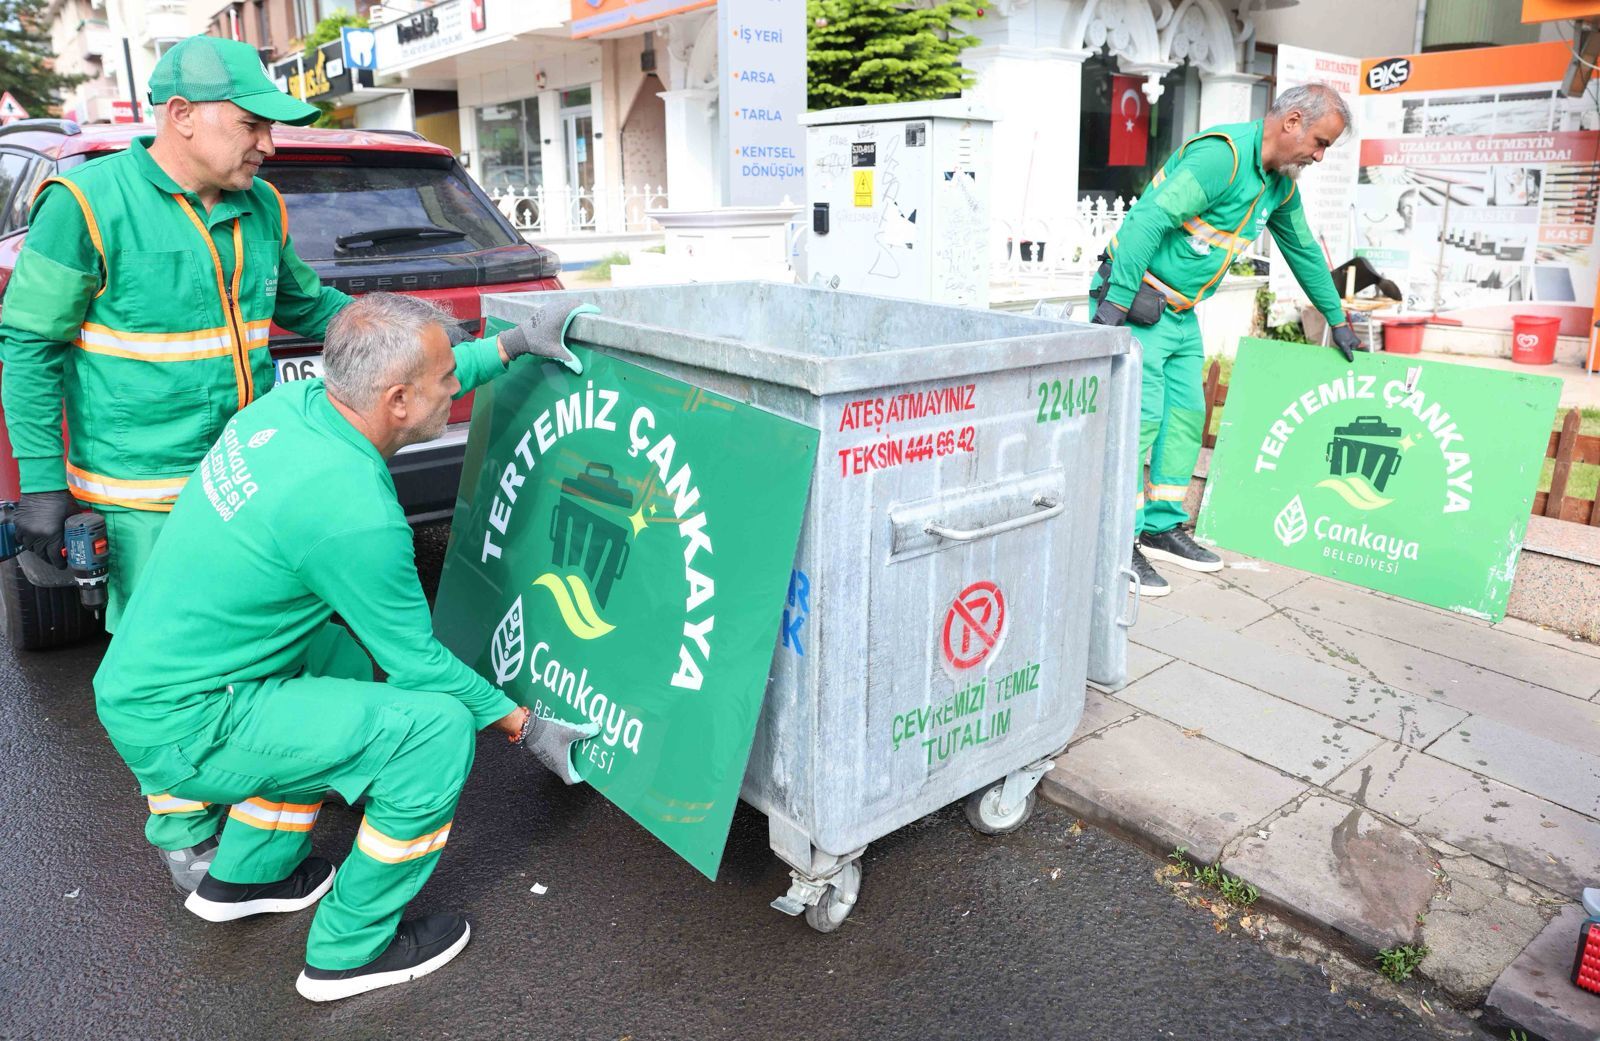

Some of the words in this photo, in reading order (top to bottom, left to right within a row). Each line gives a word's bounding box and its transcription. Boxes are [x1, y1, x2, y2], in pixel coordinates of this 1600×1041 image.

[740, 25, 752, 43] İŞ
[755, 29, 783, 43] YERİ
[740, 71, 775, 84] ARSA
[1370, 60, 1407, 88] BKS
[742, 109, 782, 121] TARLA
[742, 146, 795, 158] KENTSEL
[1399, 140, 1472, 153] UZAKLARA
[1476, 136, 1554, 150] GİTMEYİN
[1440, 151, 1498, 164] MATBAA
[1503, 149, 1572, 162] BURADA!
[742, 164, 804, 180] DÖNÜŞÜM
[1545, 229, 1588, 242] KAŞE
[839, 398, 884, 432] ATEŞ
[886, 384, 975, 423] ATMAYINIZ
[1037, 376, 1098, 423] 22442
[838, 433, 903, 477] TEKSİN
[905, 434, 933, 463] 444
[936, 430, 955, 456] 66
[957, 426, 975, 453] 42
[1254, 370, 1376, 474] TERTEMİZ
[1383, 379, 1472, 513] ÇANKAYA
[481, 380, 619, 563] TERTEMİZ
[627, 406, 715, 690] ÇANKAYA
[1314, 516, 1419, 561] Çankaya
[1323, 546, 1399, 576] BELEDİYESİ
[530, 642, 643, 754] Çankaya
[892, 676, 988, 752] ÇEVREMİZİ
[995, 661, 1040, 703] TEMİZ
[921, 708, 1011, 765] TUTALIM
